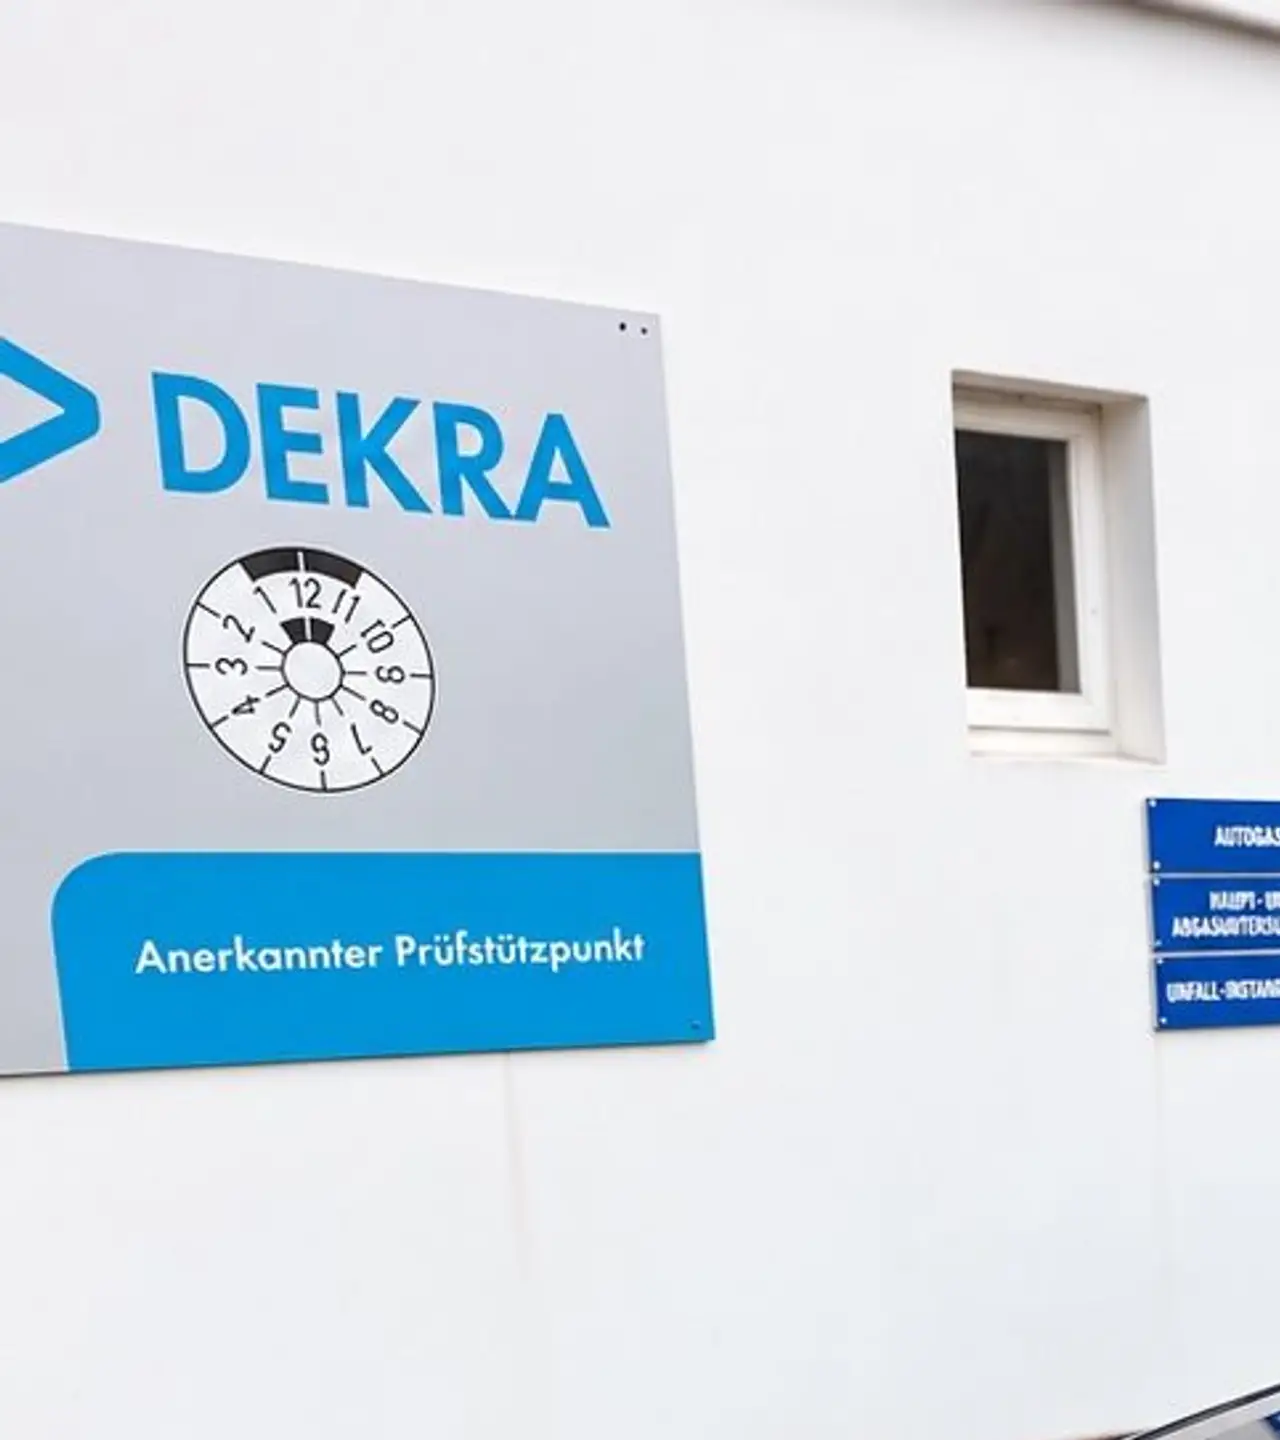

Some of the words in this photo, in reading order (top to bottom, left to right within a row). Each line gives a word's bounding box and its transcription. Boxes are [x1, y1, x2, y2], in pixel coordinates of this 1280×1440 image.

[152, 371, 611, 530] DEKRA
[254, 584, 277, 614] 1
[288, 577, 323, 610] 12
[332, 589, 361, 621] 11
[223, 613, 256, 641] 2
[361, 617, 396, 654] 10
[216, 657, 248, 676] 3
[376, 665, 406, 685] 9
[232, 695, 262, 717] 4
[370, 698, 400, 723] 8
[268, 722, 292, 754] 5
[311, 732, 331, 766] 6
[350, 721, 374, 756] 7
[134, 938, 384, 976] Anerkannter
[396, 927, 647, 974] Prüfstützpunkt
